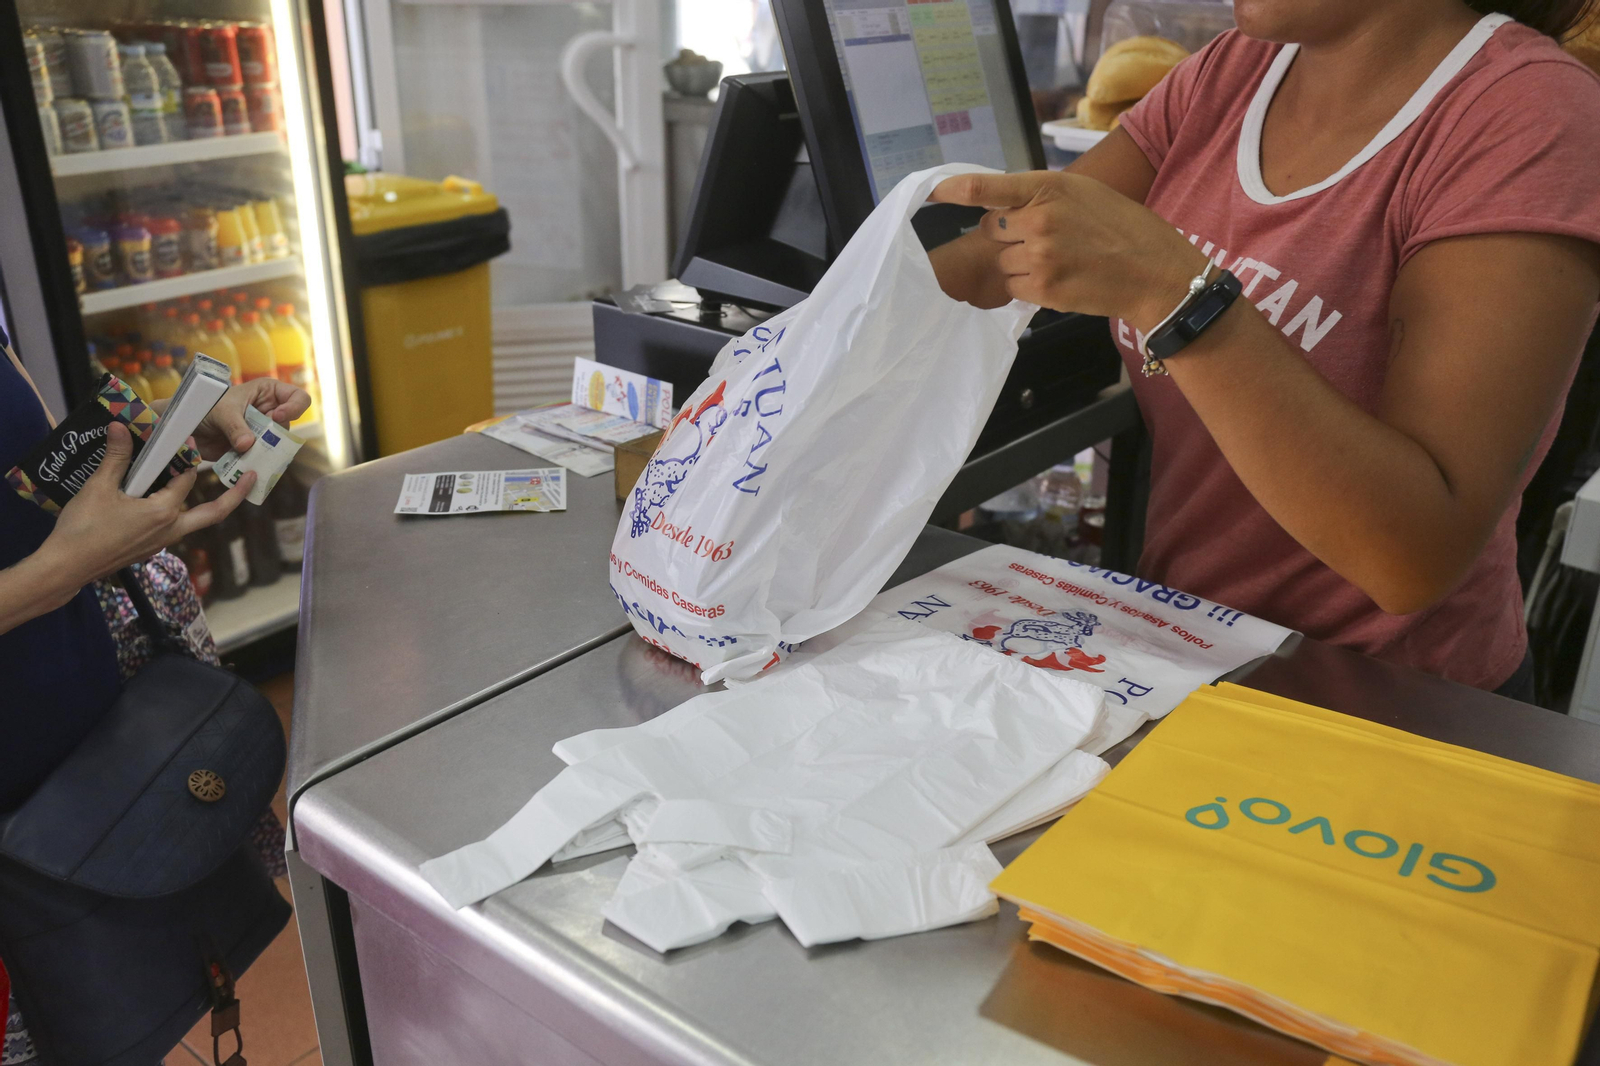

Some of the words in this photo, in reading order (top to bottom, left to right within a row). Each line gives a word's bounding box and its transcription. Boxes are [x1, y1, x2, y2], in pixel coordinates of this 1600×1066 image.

[38, 451, 67, 482] Todo
[650, 510, 694, 548] Desde
[693, 535, 734, 562] 1963
[1008, 562, 1055, 586] Caseras
[624, 561, 669, 600] Comidas
[671, 591, 725, 619] Caseras
[968, 579, 1010, 597] 1963
[1055, 580, 1108, 605] Comidas
[1008, 594, 1057, 617] Desde
[1109, 600, 1122, 609] y
[1120, 604, 1170, 628] Asados
[1170, 625, 1213, 650] Pollos
